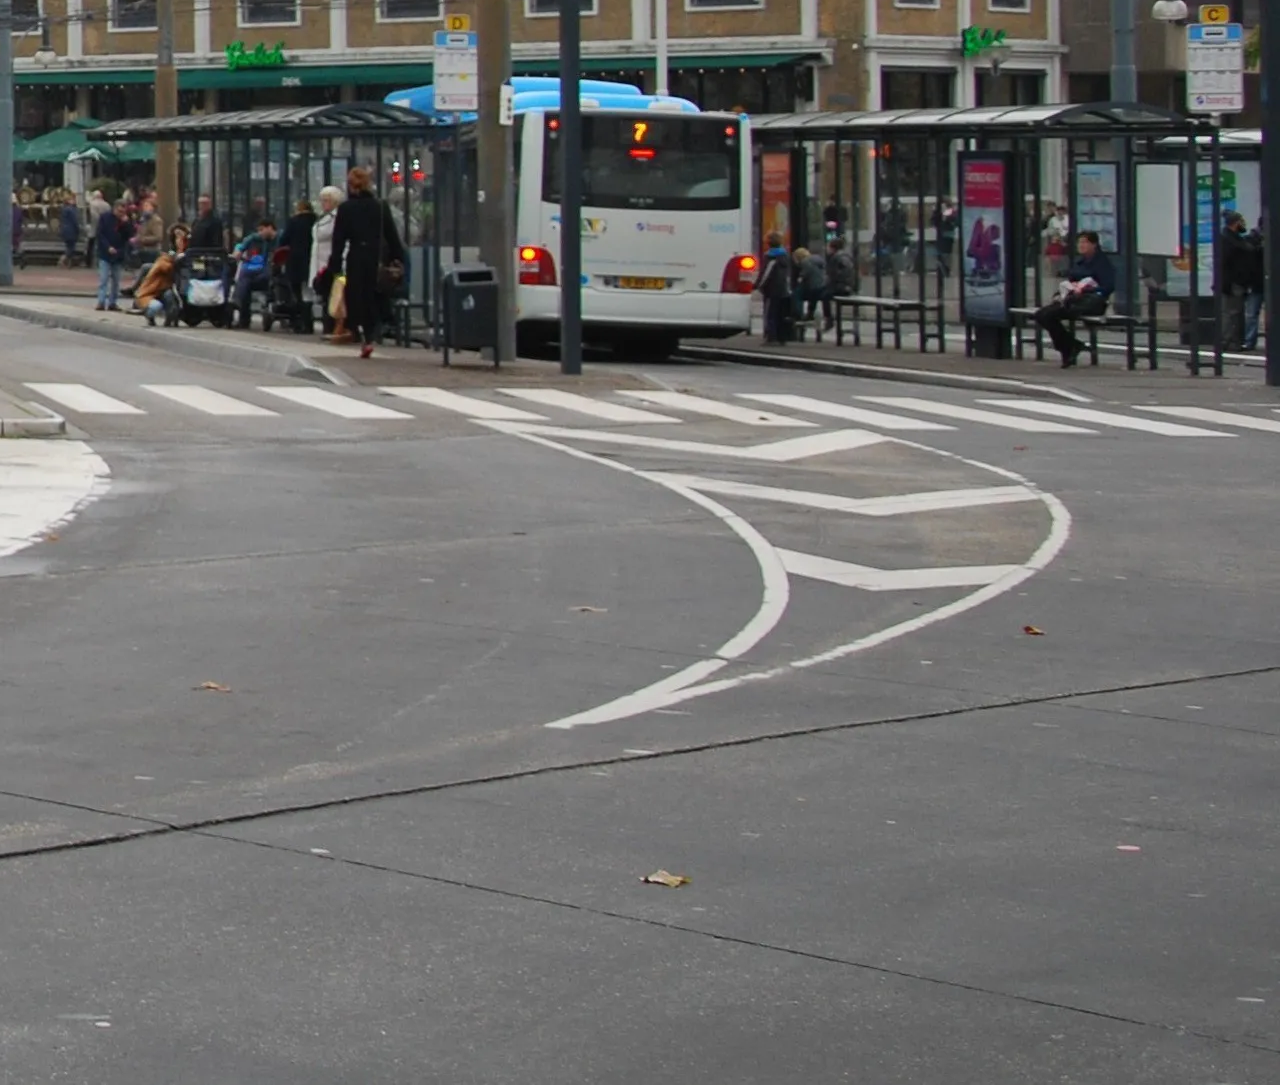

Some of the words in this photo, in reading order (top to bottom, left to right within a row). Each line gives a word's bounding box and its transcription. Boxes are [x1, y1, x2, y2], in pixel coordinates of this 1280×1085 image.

[1206, 8, 1220, 21] C
[451, 17, 463, 30] D
[633, 123, 647, 142] 7
